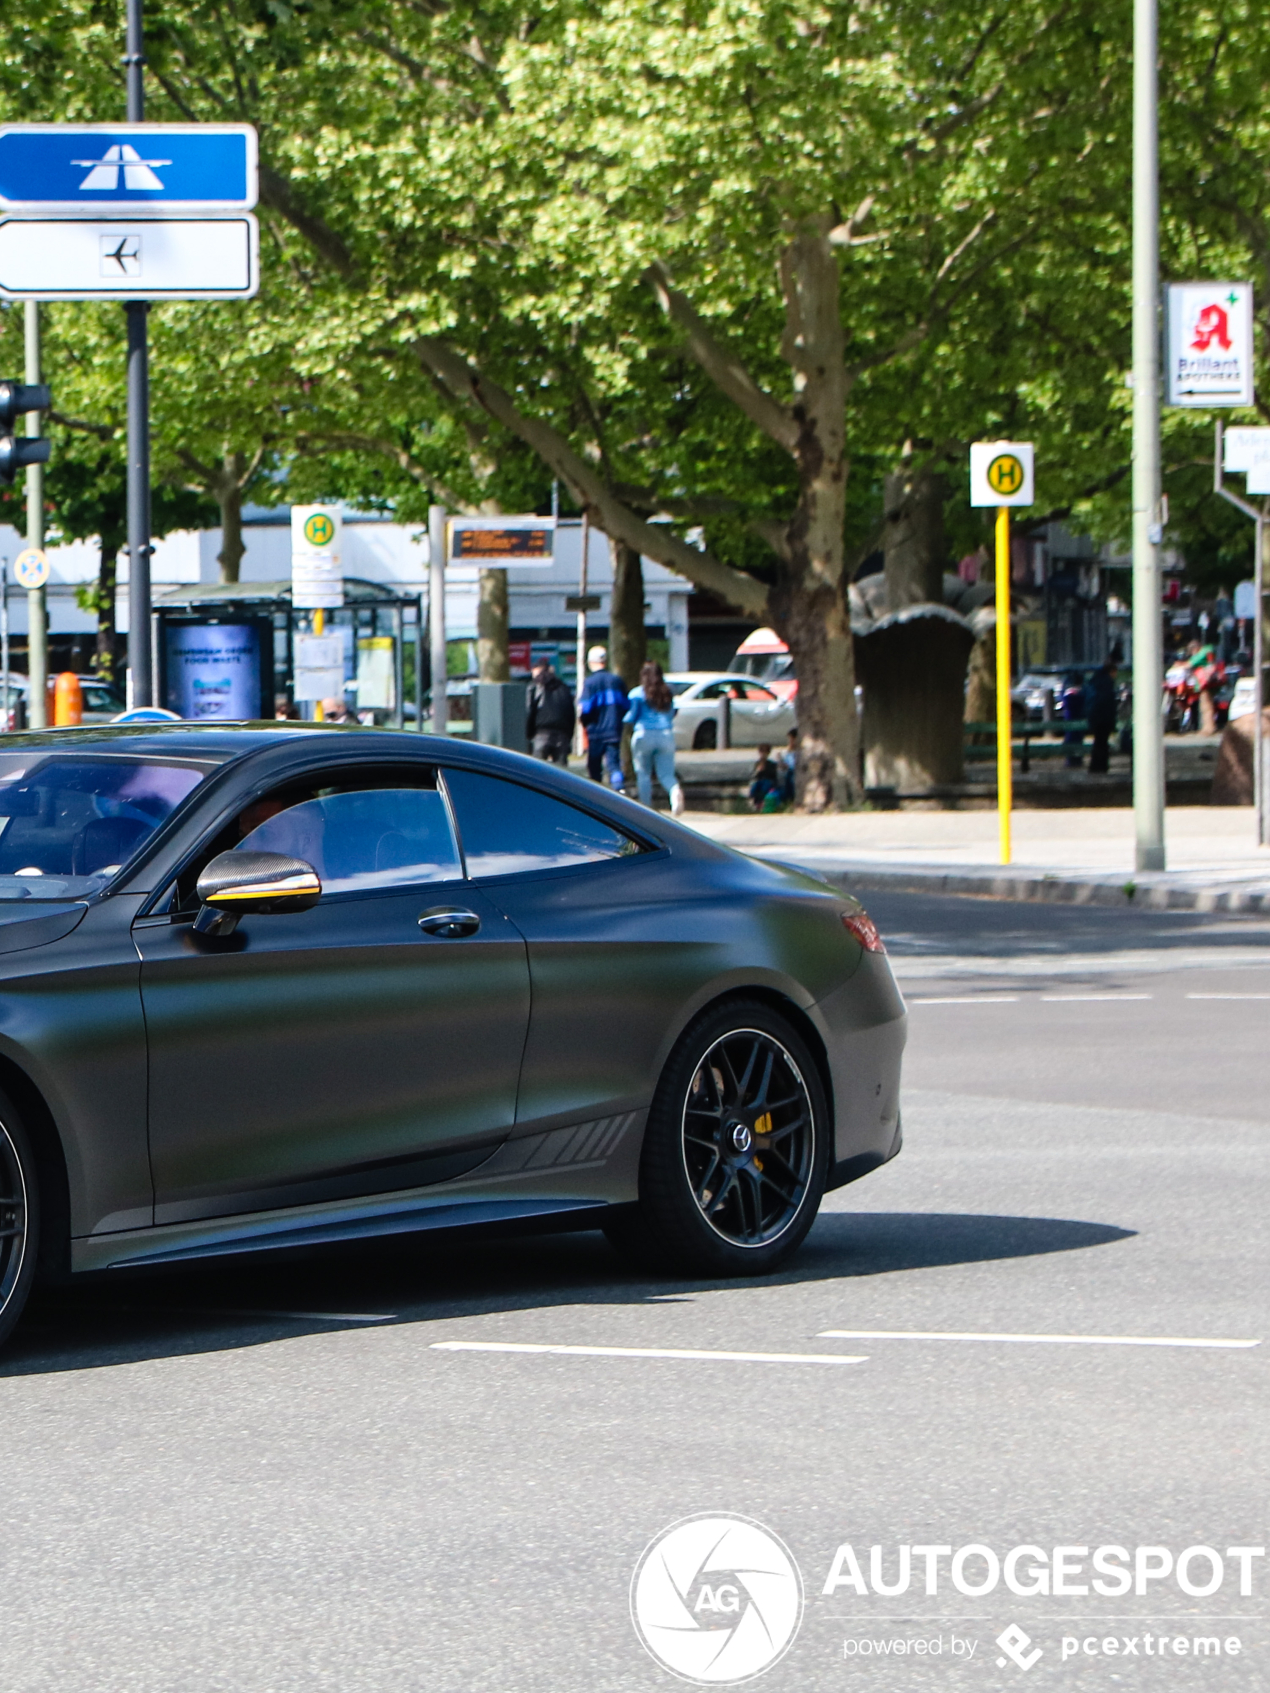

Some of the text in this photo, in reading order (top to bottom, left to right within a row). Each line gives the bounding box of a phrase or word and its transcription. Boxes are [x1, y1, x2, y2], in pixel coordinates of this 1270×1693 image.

[1178, 358, 1239, 372] Brillant
[1176, 372, 1241, 382] APOTHEKE
[998, 464, 1015, 486] H
[313, 522, 327, 538] H
